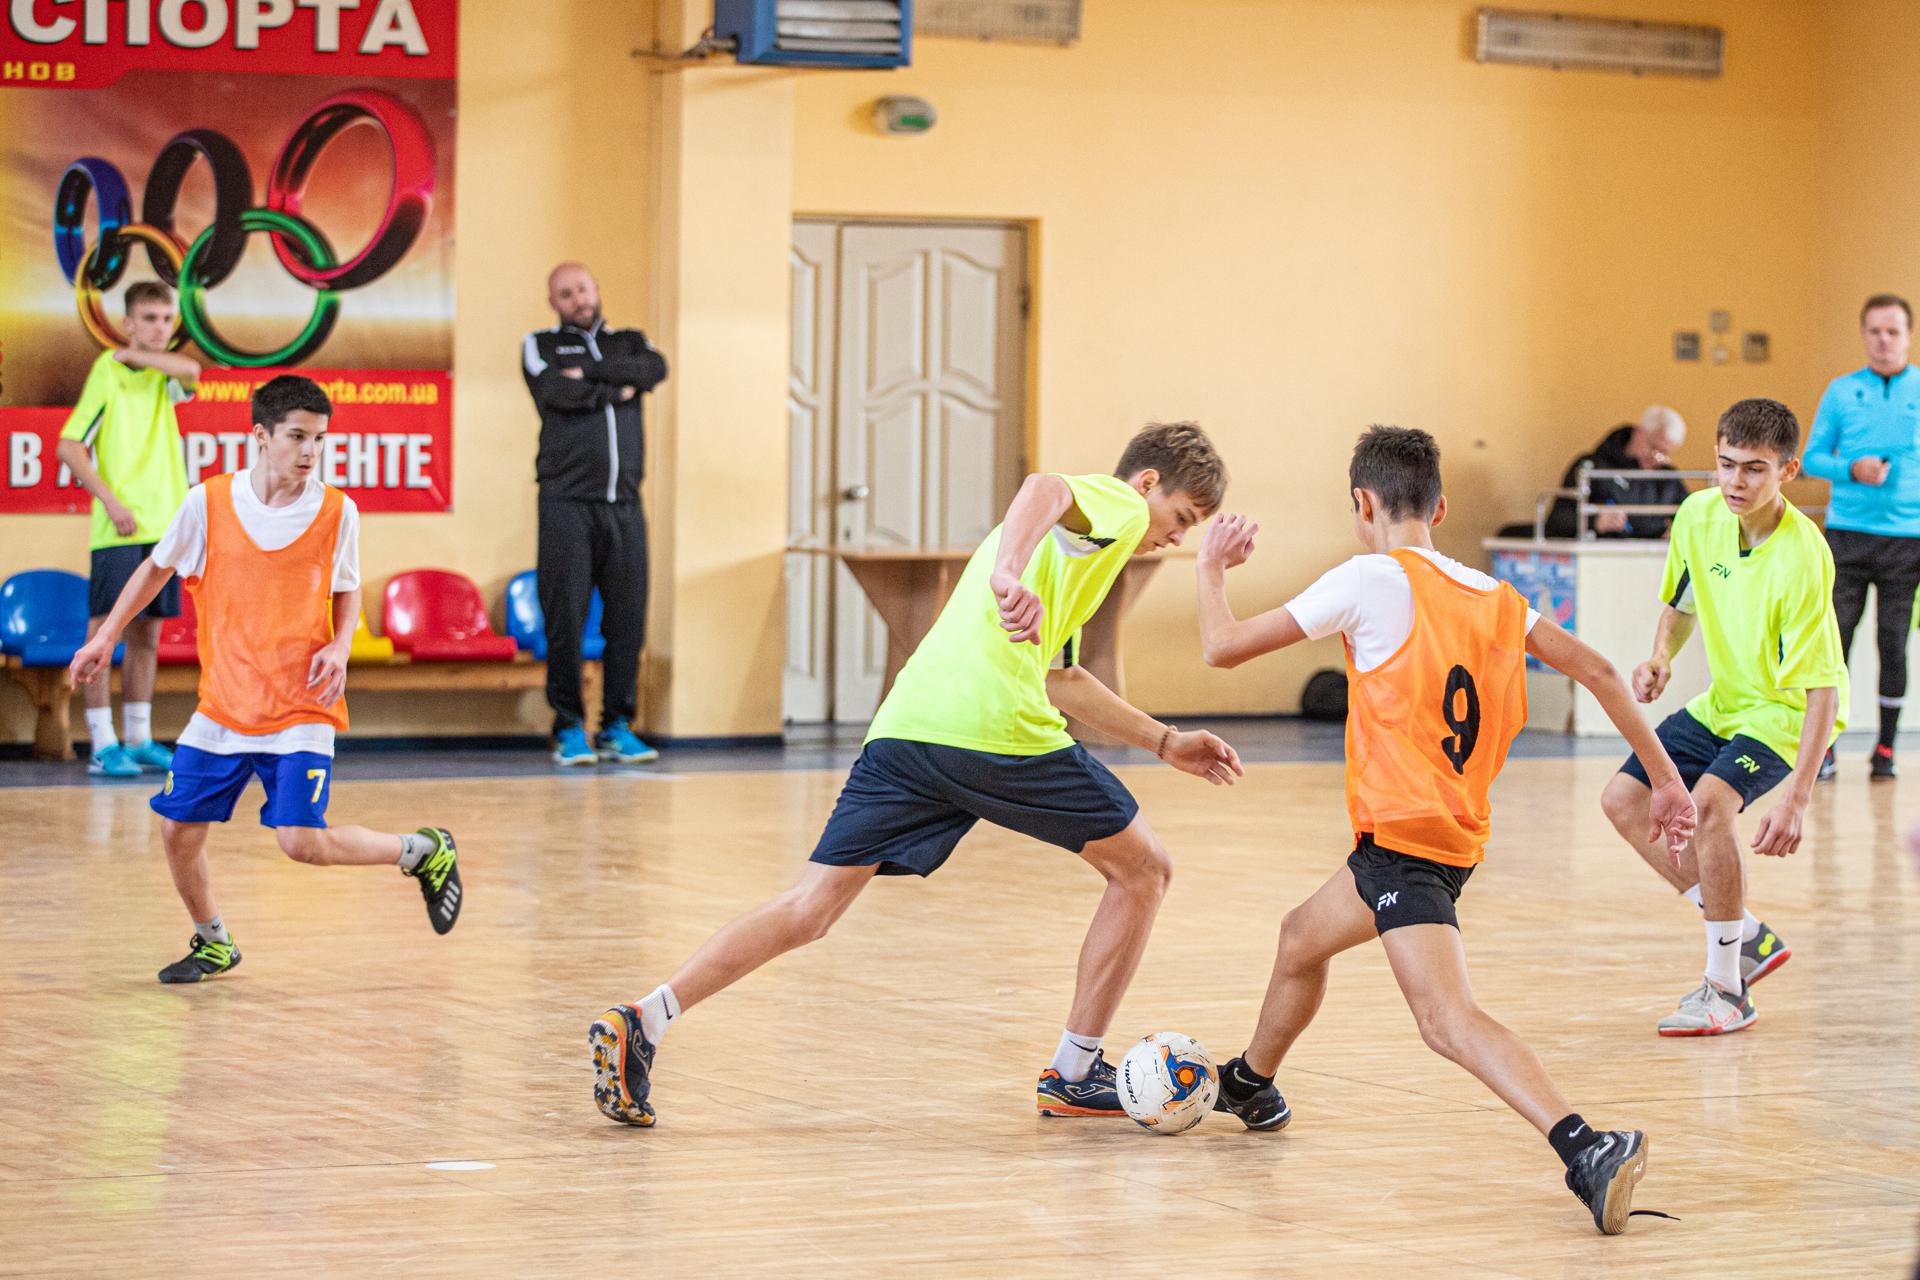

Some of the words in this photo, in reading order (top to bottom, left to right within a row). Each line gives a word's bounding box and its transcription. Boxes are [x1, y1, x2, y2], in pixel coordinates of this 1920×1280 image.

[9, 0, 430, 55] СПОРТА
[3, 61, 76, 81] НОВ
[10, 431, 42, 488] В
[1441, 664, 1480, 775] 9
[307, 768, 326, 803] 7
[1124, 1058, 1138, 1105] DEMIX
